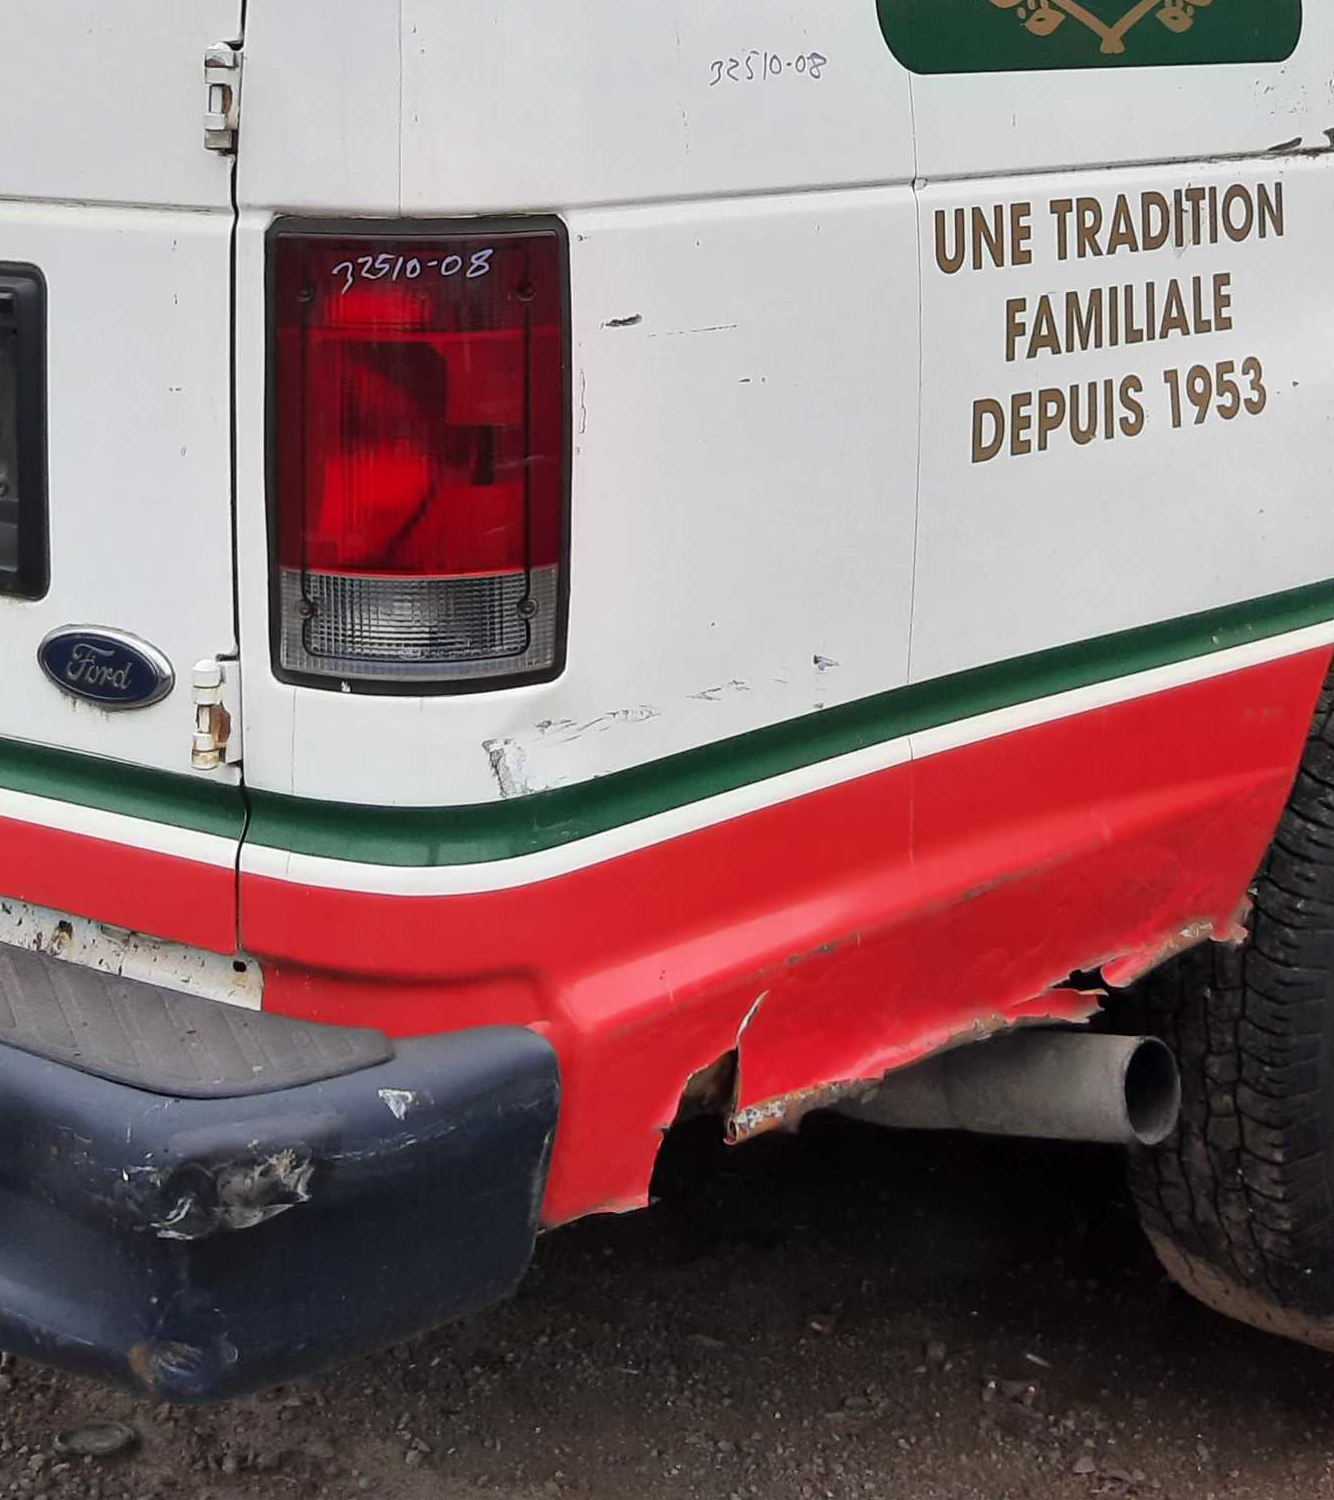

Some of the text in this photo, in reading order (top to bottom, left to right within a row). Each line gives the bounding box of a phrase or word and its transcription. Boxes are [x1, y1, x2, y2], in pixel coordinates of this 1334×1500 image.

[709, 50, 828, 86] 32510-08
[934, 181, 1285, 275] UNE TRADITION
[1005, 272, 1233, 362] FAMILIALE
[971, 356, 1267, 463] DEPUIS 1953
[67, 643, 132, 690] Ford
